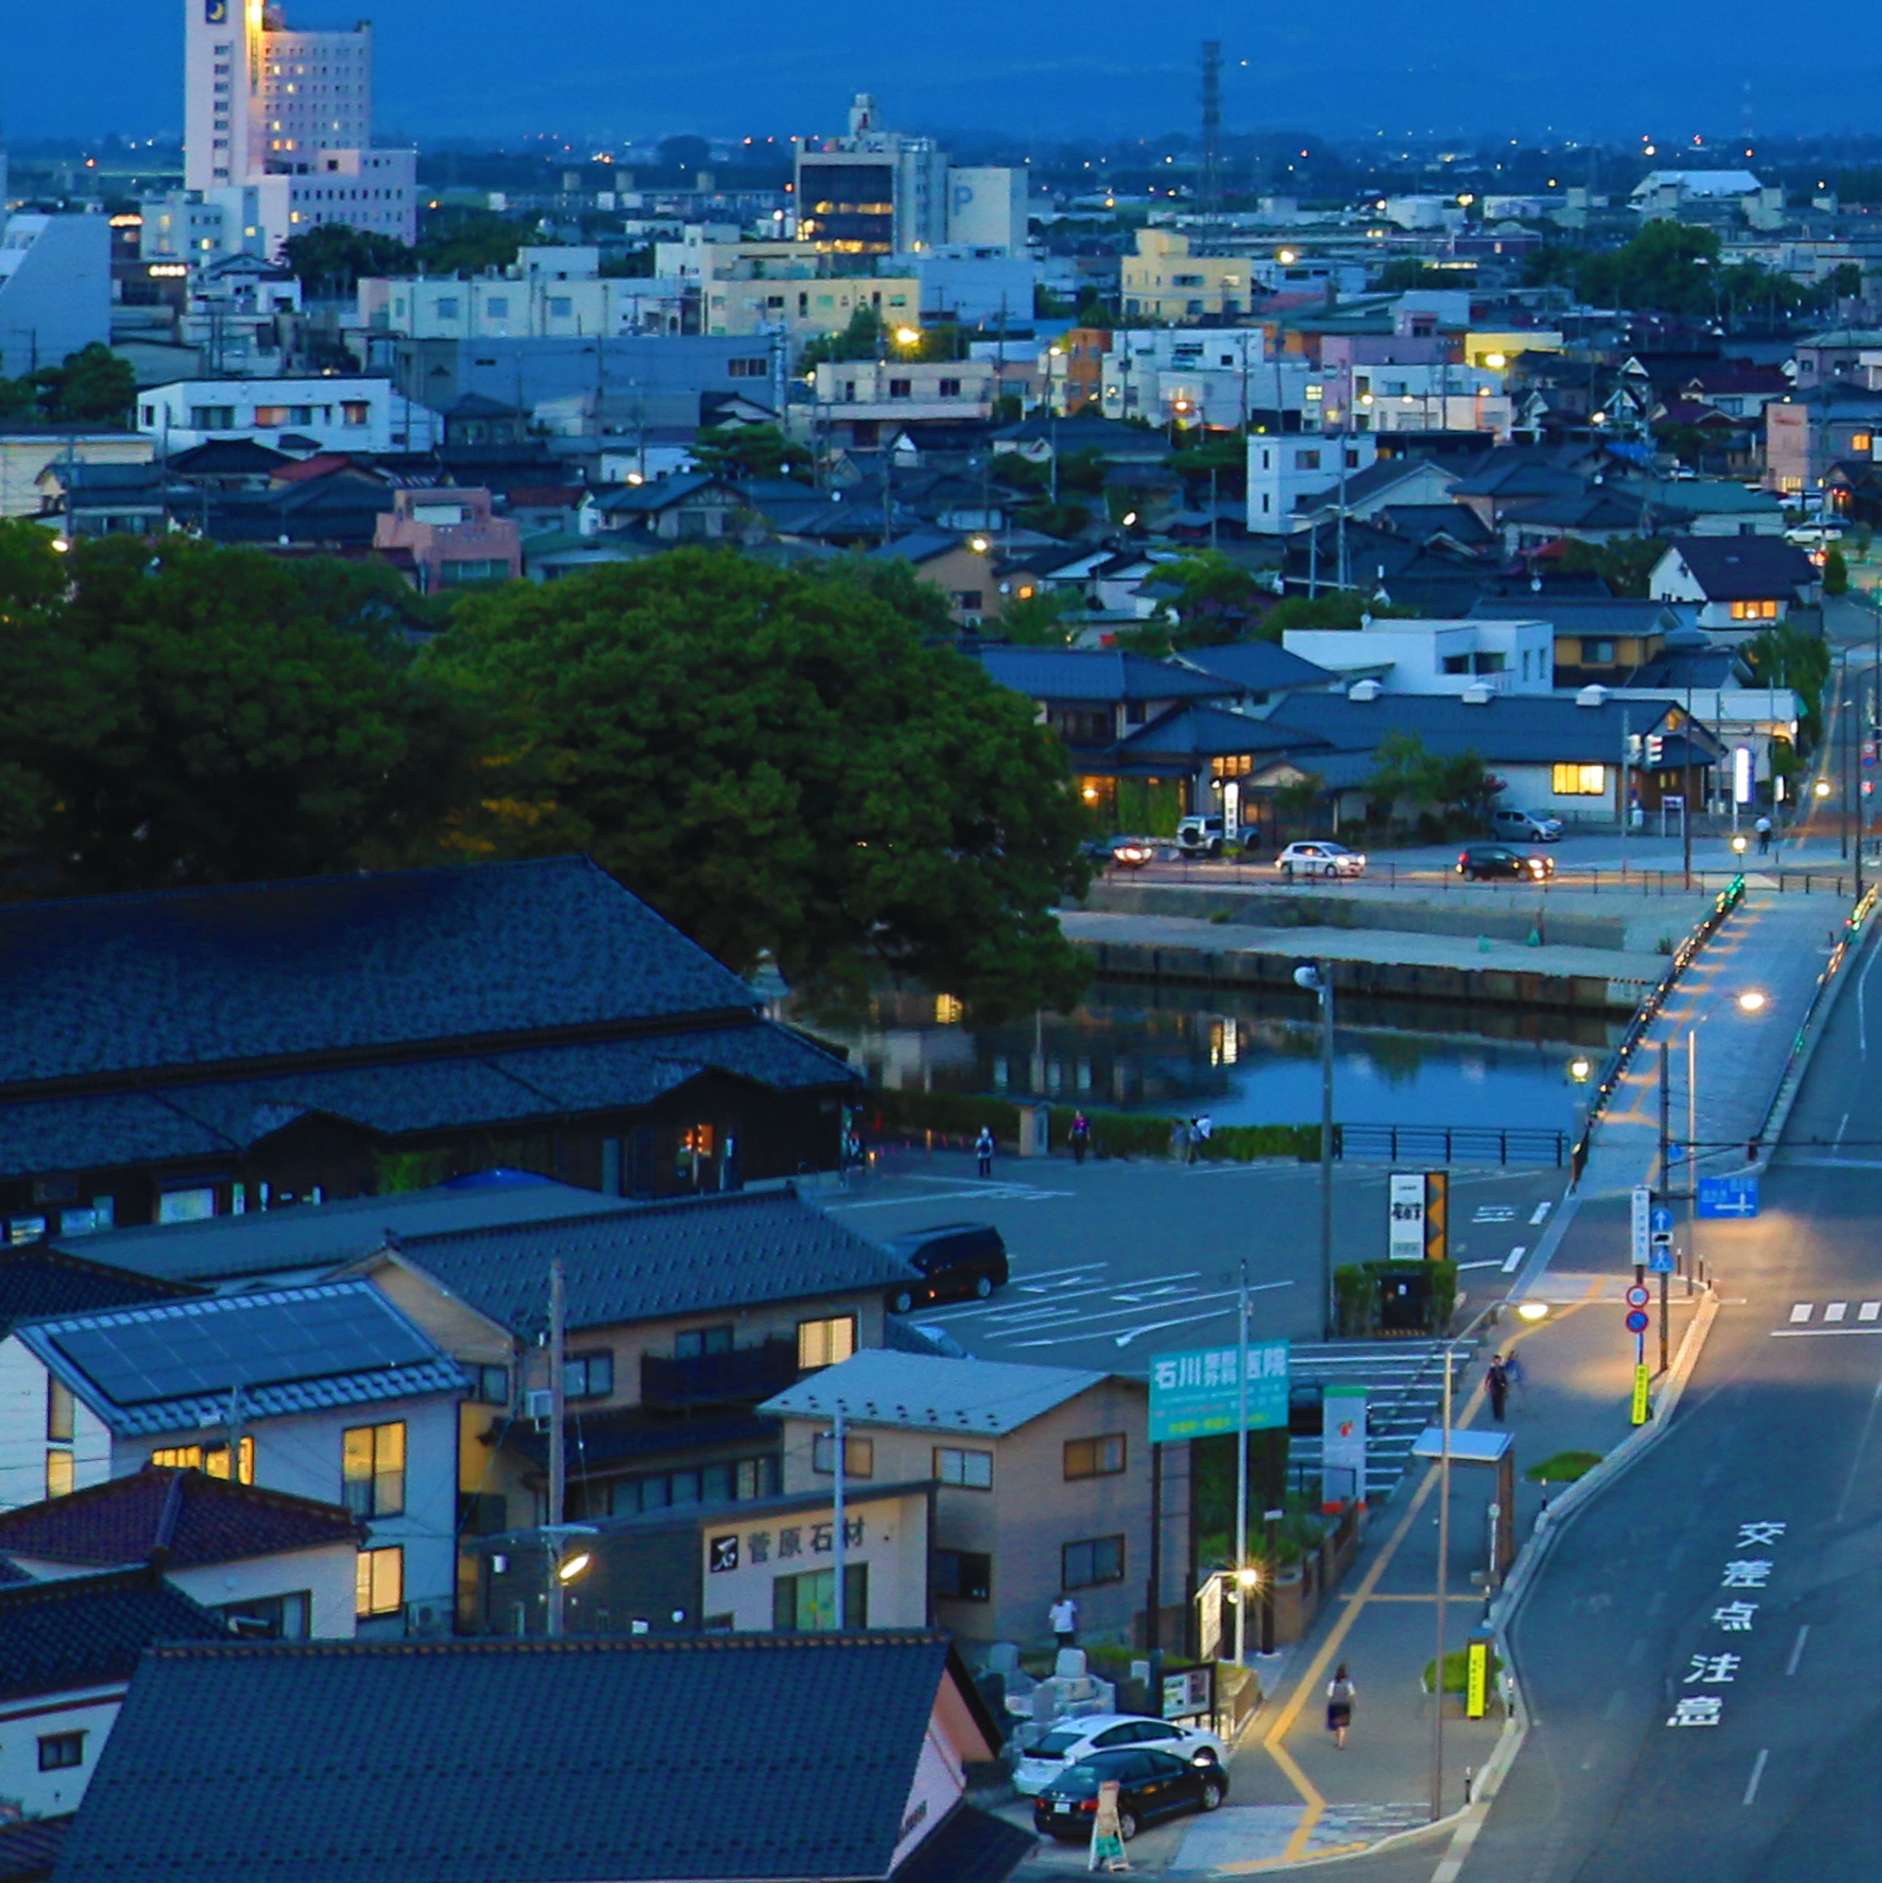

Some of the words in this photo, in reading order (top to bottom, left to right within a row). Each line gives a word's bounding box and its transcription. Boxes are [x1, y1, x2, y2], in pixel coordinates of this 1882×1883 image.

[954, 186, 974, 216] P
[748, 1516, 864, 1564] 菅原石材
[1666, 1521, 1787, 1727] 交差点注意
